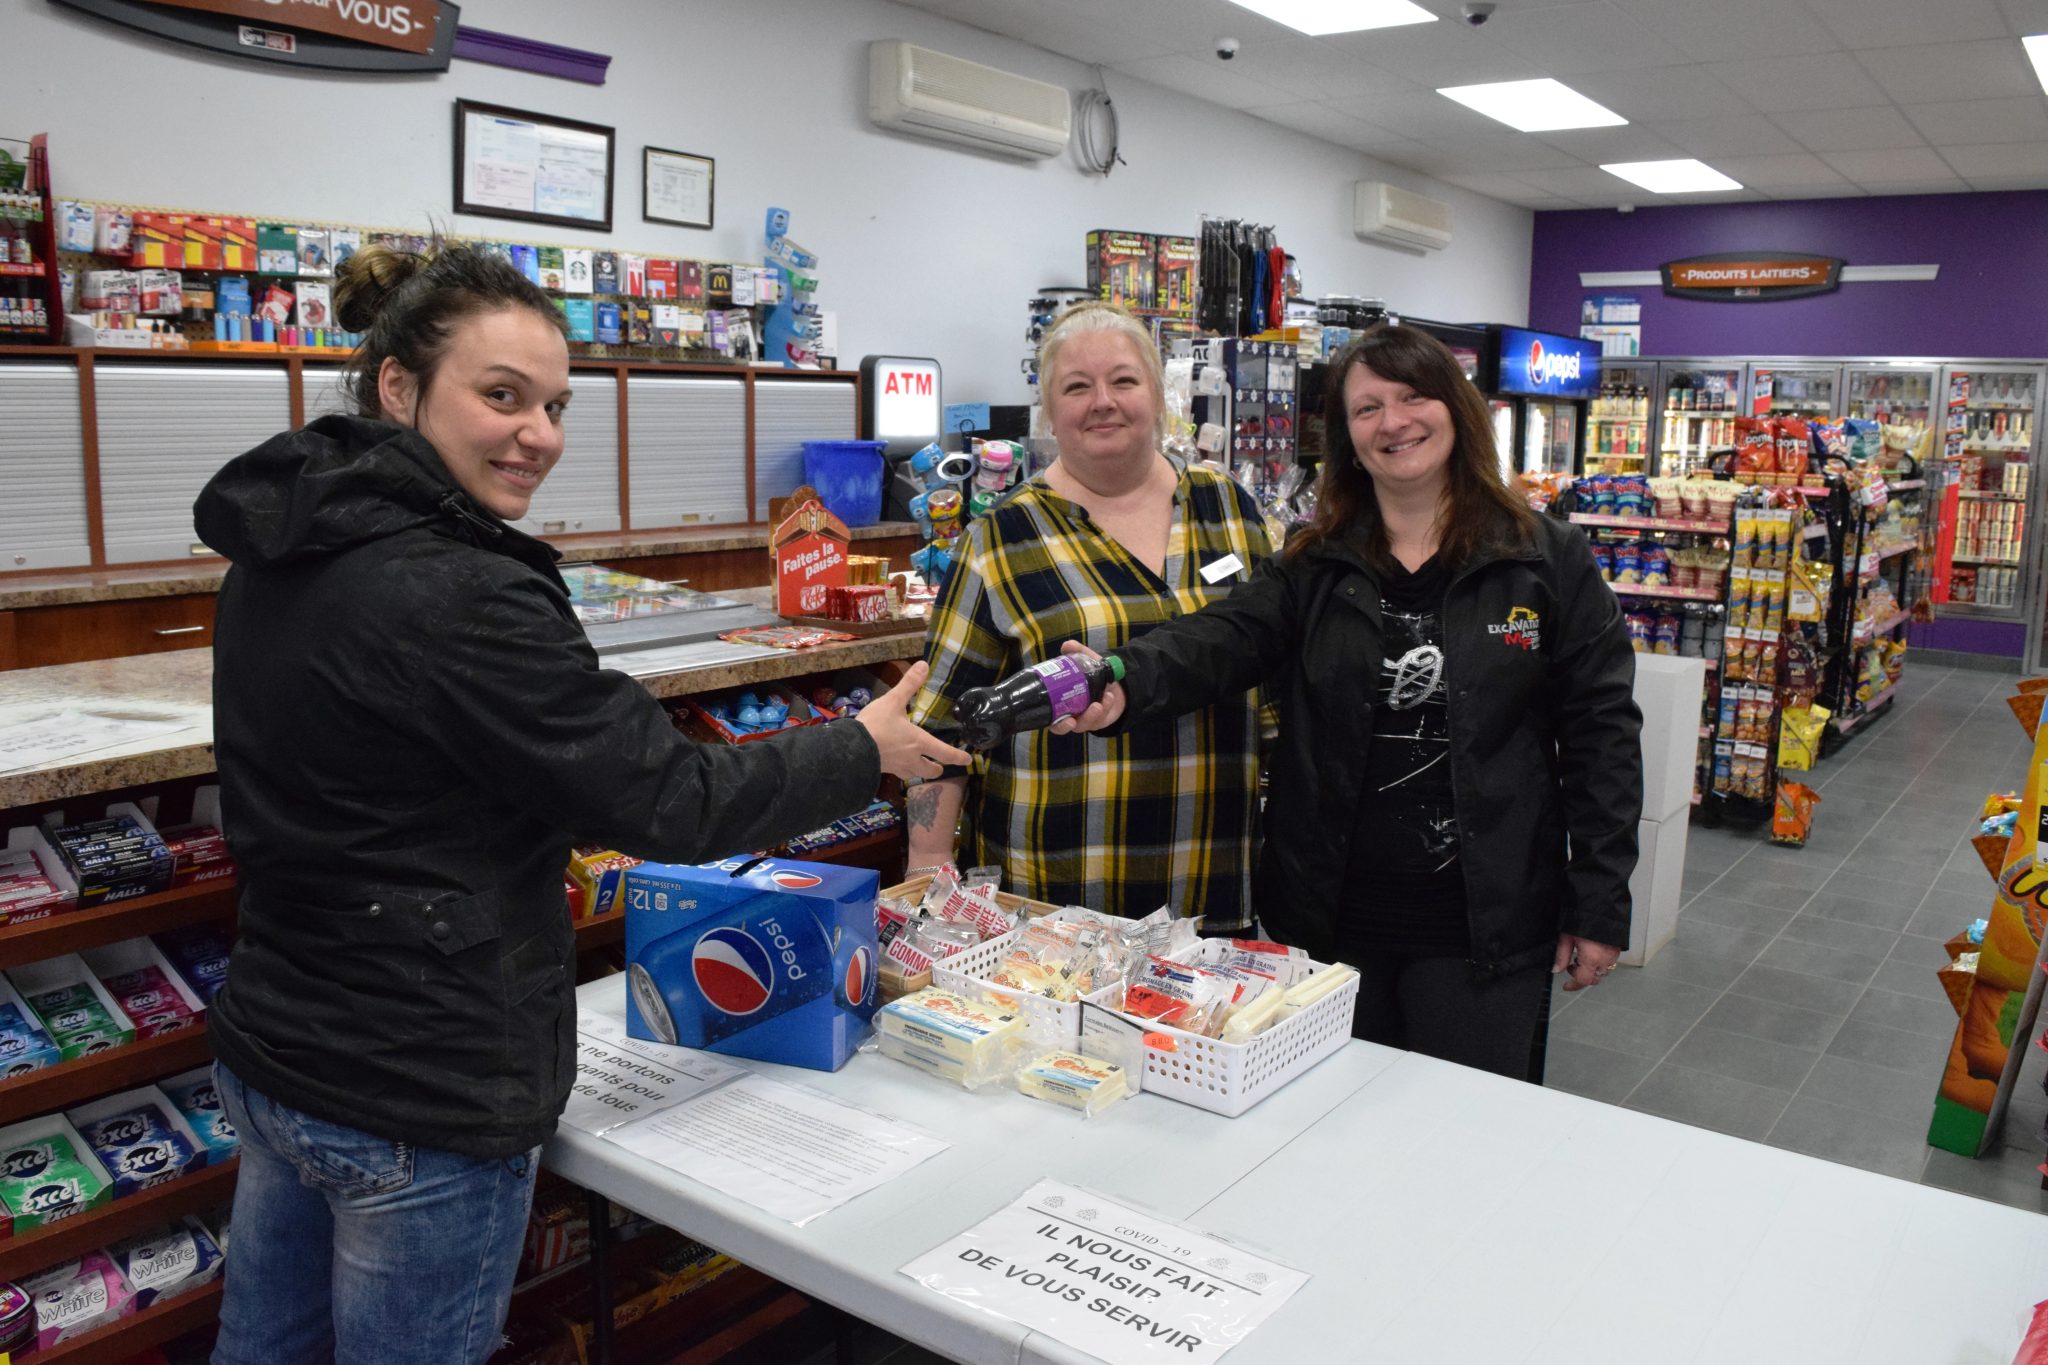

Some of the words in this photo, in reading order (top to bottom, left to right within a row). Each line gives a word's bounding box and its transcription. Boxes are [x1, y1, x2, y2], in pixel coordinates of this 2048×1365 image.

[336, 0, 412, 36] VOUS
[1109, 246, 1132, 255] BOMB
[1132, 248, 1147, 256] BOX
[1113, 239, 1141, 247] CHERRY
[102, 276, 138, 289] Energizer
[144, 275, 178, 288] Energizer
[1687, 269, 1748, 281] PRODUITS
[1751, 267, 1810, 279] LAITIERS
[1545, 351, 1580, 385] pepsi
[884, 371, 933, 396] ATM
[782, 549, 820, 575] Faites
[822, 543, 835, 557] la
[805, 553, 844, 581] pause.
[78, 843, 106, 854] HALLS
[85, 855, 112, 866] HALLS
[193, 866, 233, 882] HALLS
[104, 885, 147, 902] HALLS
[600, 889, 613, 906] 2
[632, 888, 651, 911] 12
[9, 908, 52, 925] HALLS
[961, 899, 982, 922] UNE
[757, 916, 808, 981] pepsi
[1172, 985, 1194, 1000] GRAINS
[53, 1008, 89, 1029] excel
[619, 1038, 650, 1052] COVID
[655, 1051, 669, 1059] 19
[576, 1063, 624, 1085] gants
[584, 1046, 609, 1059] ne
[603, 1054, 676, 1085] portons
[572, 1084, 599, 1097] de
[597, 1093, 639, 1113] tous
[93, 1113, 151, 1148] excel
[0, 1143, 55, 1180] excel
[118, 1140, 176, 1174] excel
[20, 1177, 82, 1214] excel
[1113, 1225, 1160, 1247] COVID
[1172, 1246, 1192, 1257] 19
[1036, 1223, 1059, 1241] IL
[1066, 1234, 1152, 1271] NOUS
[1152, 1266, 1226, 1299] FAIT
[958, 1248, 1003, 1271] DE
[1004, 1264, 1086, 1302] VOUS
[1087, 1297, 1203, 1353] SERVIR
